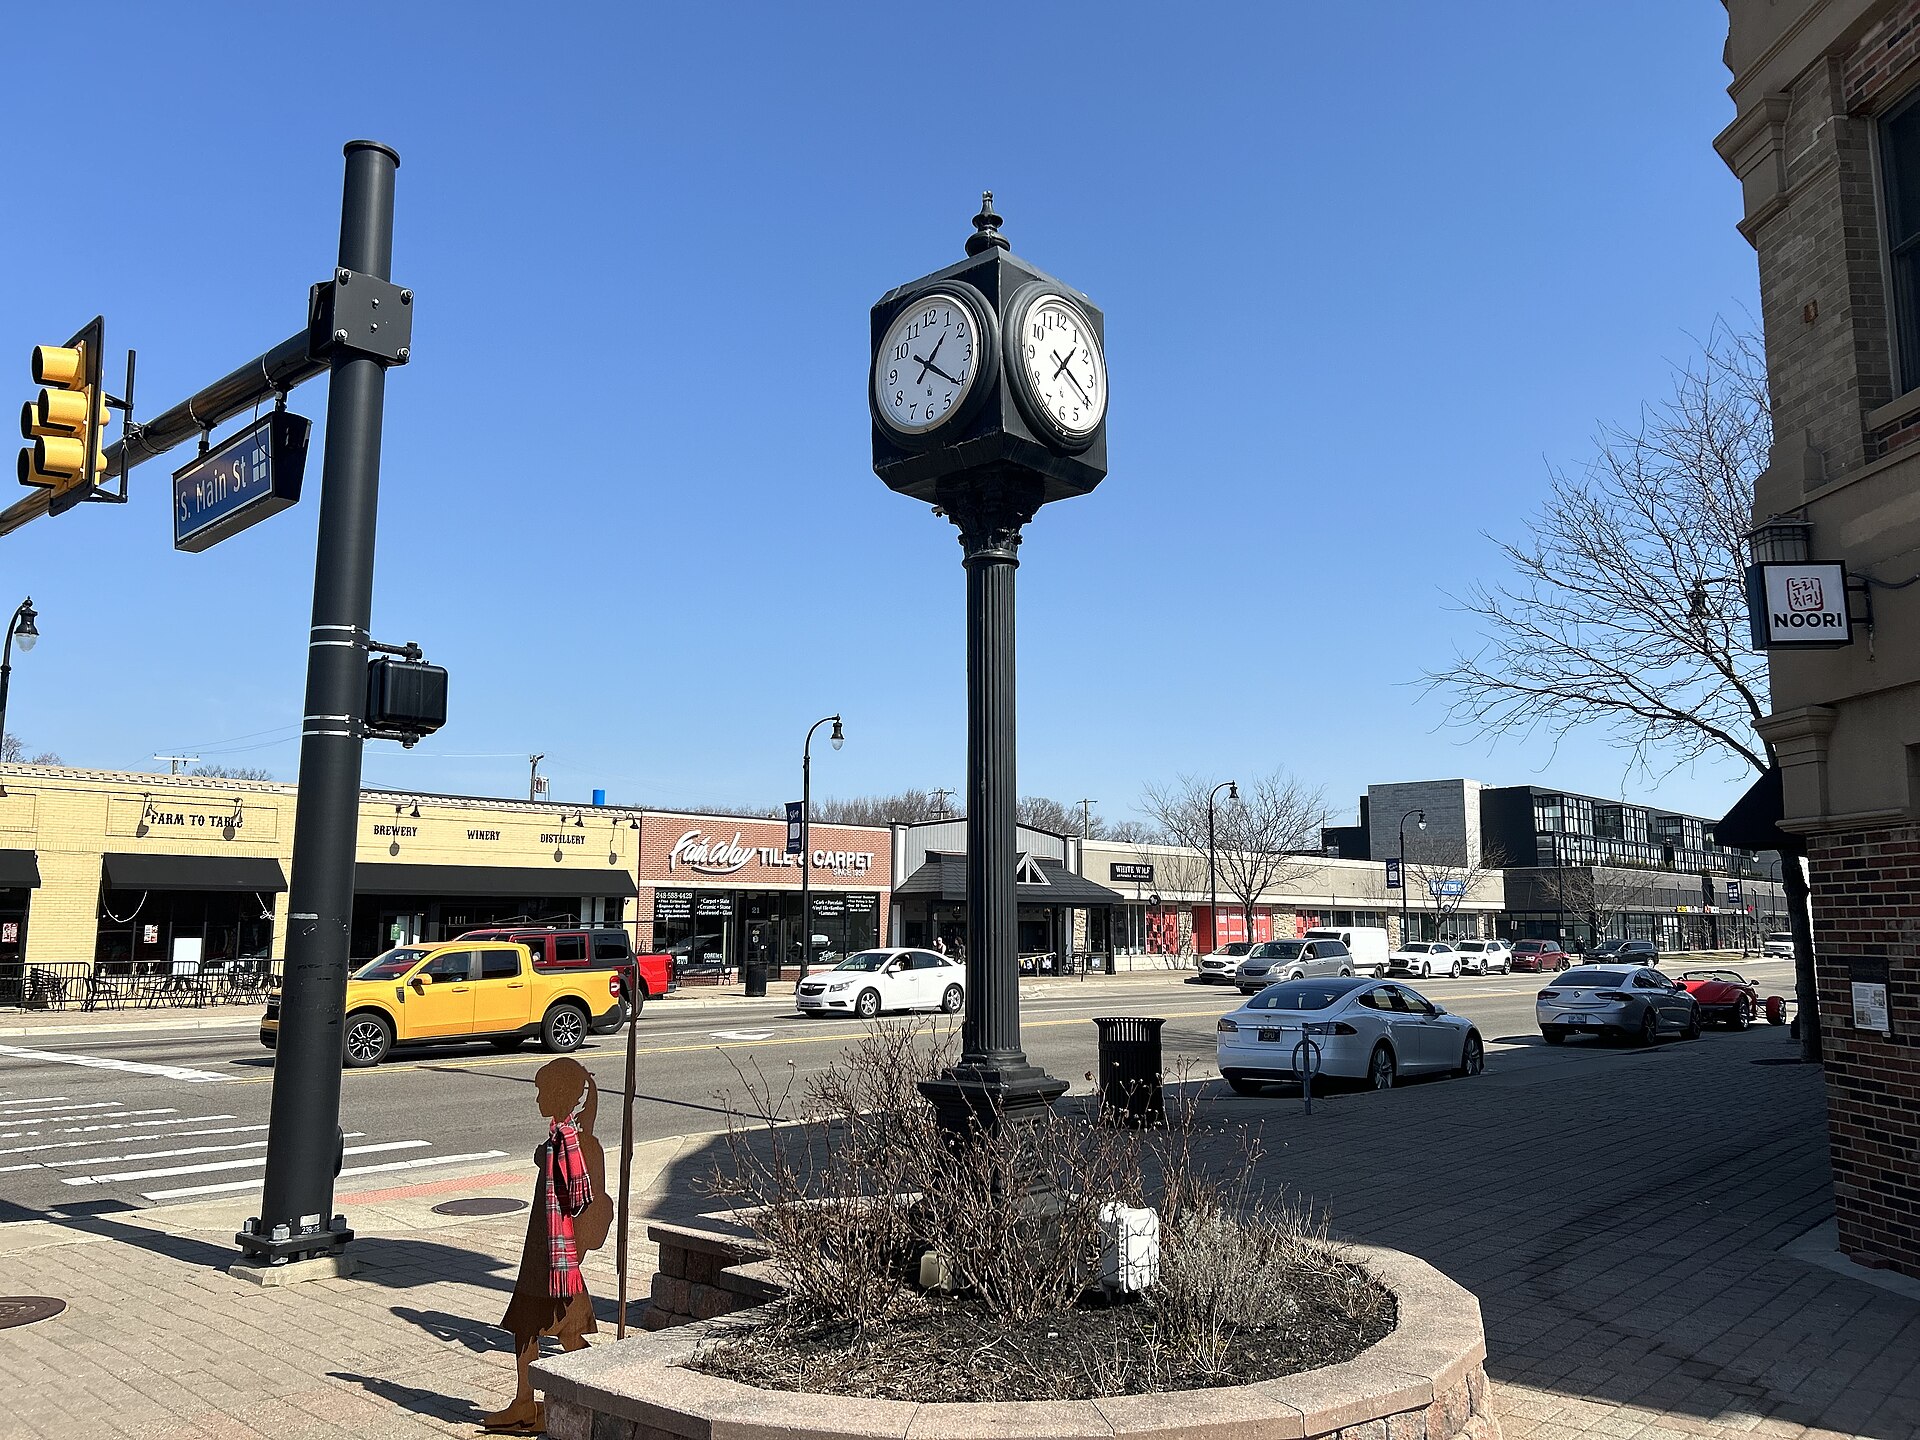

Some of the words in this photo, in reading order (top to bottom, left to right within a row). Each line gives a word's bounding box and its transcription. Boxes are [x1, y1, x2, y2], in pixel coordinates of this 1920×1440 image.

[923, 310, 938, 328] 12
[944, 311, 952, 327] 1
[1042, 313, 1052, 331] 11
[1055, 312, 1068, 331] 12
[906, 323, 921, 341] 11
[956, 323, 965, 339] 2
[1032, 324, 1044, 341] 10
[1073, 329, 1078, 343] 1
[894, 343, 909, 361] 10
[963, 344, 972, 361] 3
[1029, 348, 1035, 359] 9
[1082, 349, 1089, 364] 2
[889, 370, 898, 385] 9
[958, 370, 966, 385] 4
[1035, 371, 1040, 385] 8
[1087, 375, 1094, 388] 3
[895, 391, 903, 406] 8
[943, 391, 952, 410] 5
[1046, 395, 1052, 406] 7
[910, 403, 917, 420] 7
[925, 404, 934, 420] 6
[1059, 406, 1066, 420] 6
[1073, 407, 1079, 421] 5
[180, 491, 191, 522] S.
[196, 469, 227, 513] Main
[232, 455, 247, 492] St
[1791, 580, 1814, 595] 누리
[1793, 591, 1821, 607] 치킨
[1773, 613, 1843, 628] NOORI
[150, 813, 185, 825] FARM
[189, 815, 205, 826] TO
[374, 825, 418, 837] BREWERY
[467, 829, 501, 841] WINERY
[540, 833, 586, 845] DISTILLERY
[757, 848, 794, 867] TILE
[812, 849, 875, 869] CARPET
[1115, 865, 1135, 874] WHITE
